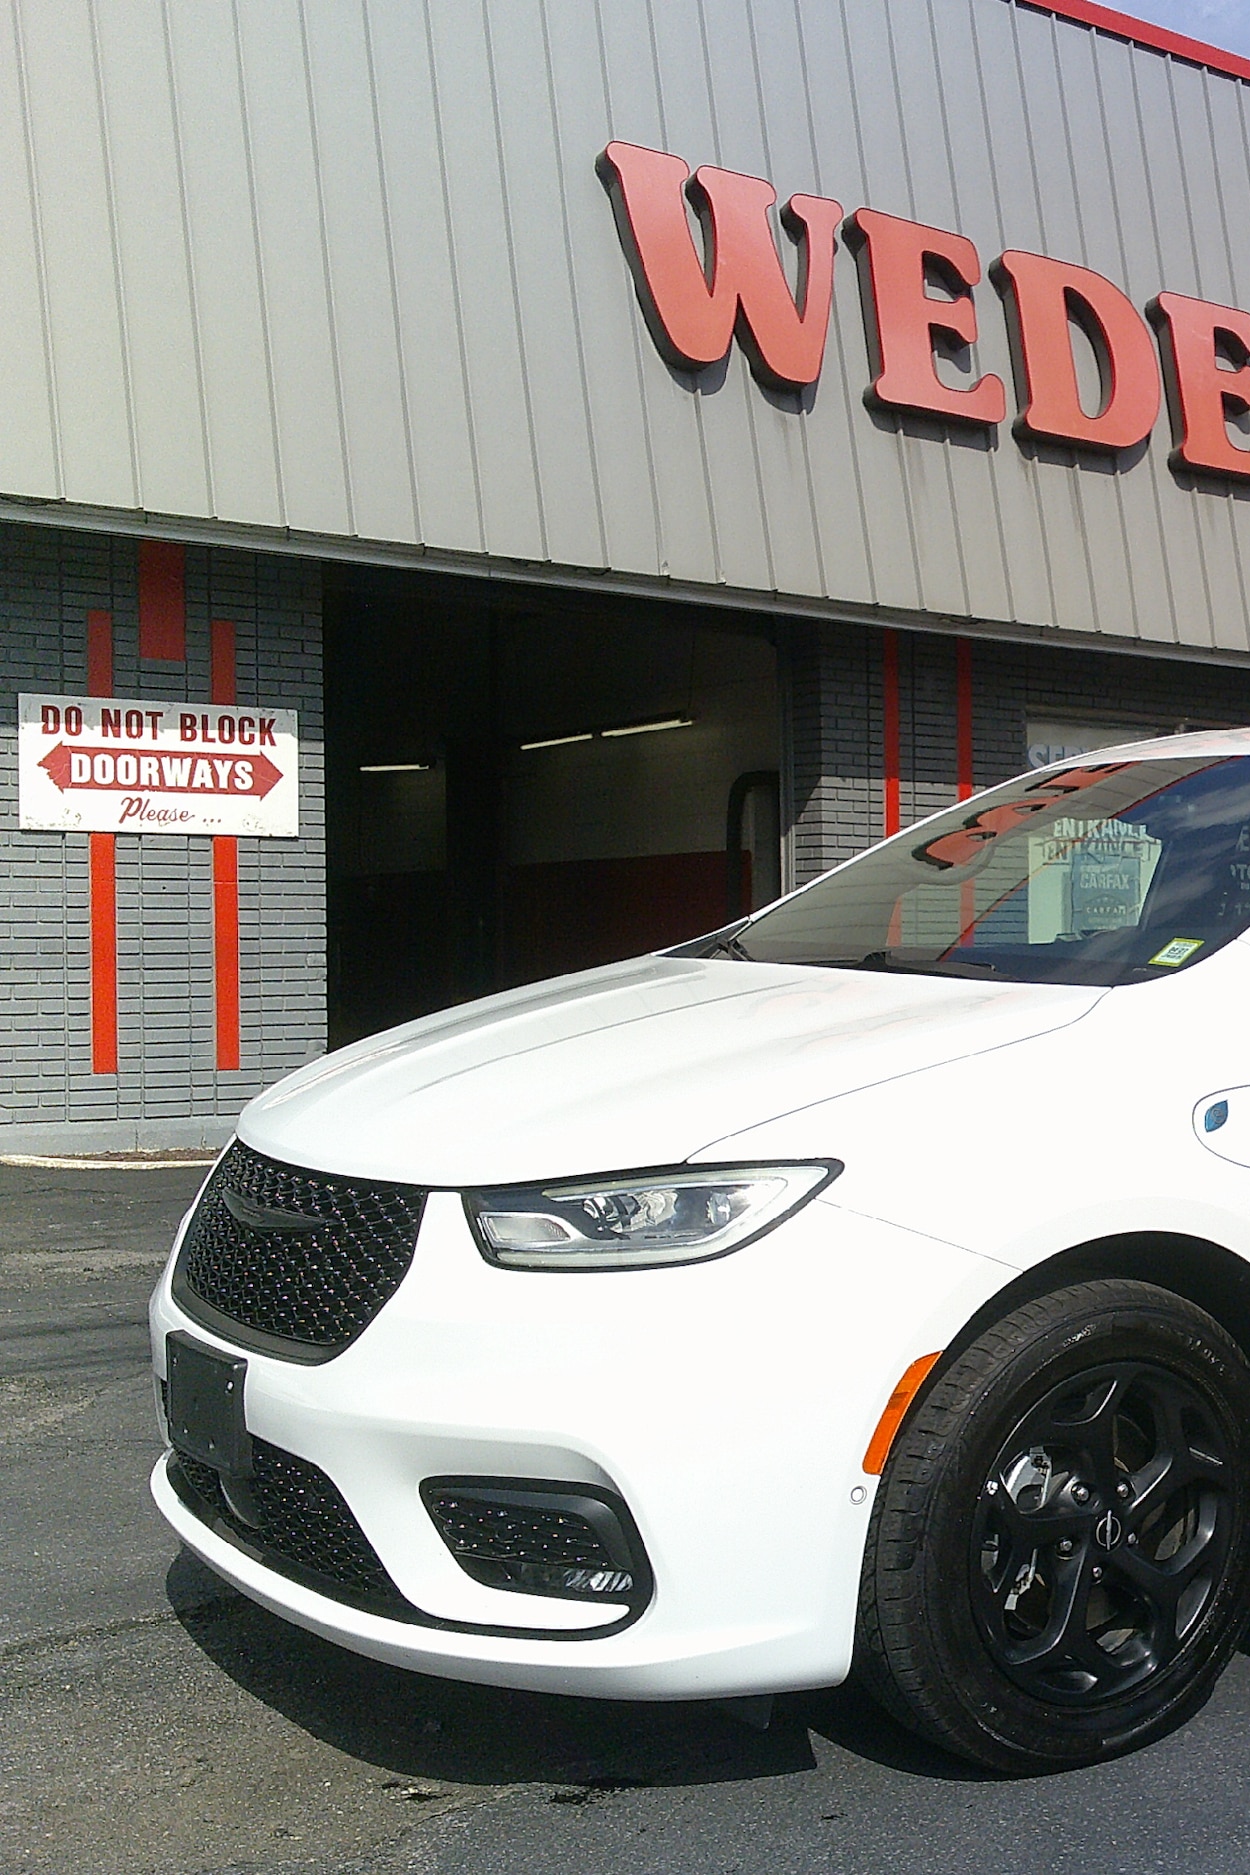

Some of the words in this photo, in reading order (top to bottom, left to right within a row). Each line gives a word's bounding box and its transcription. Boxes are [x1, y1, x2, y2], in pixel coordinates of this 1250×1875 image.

[41, 704, 83, 735] DO
[101, 708, 163, 740] NOT
[180, 712, 277, 746] BLOCK
[70, 752, 255, 790] DOORWAYS
[118, 797, 196, 824] Please
[1080, 872, 1130, 890] CARFAX
